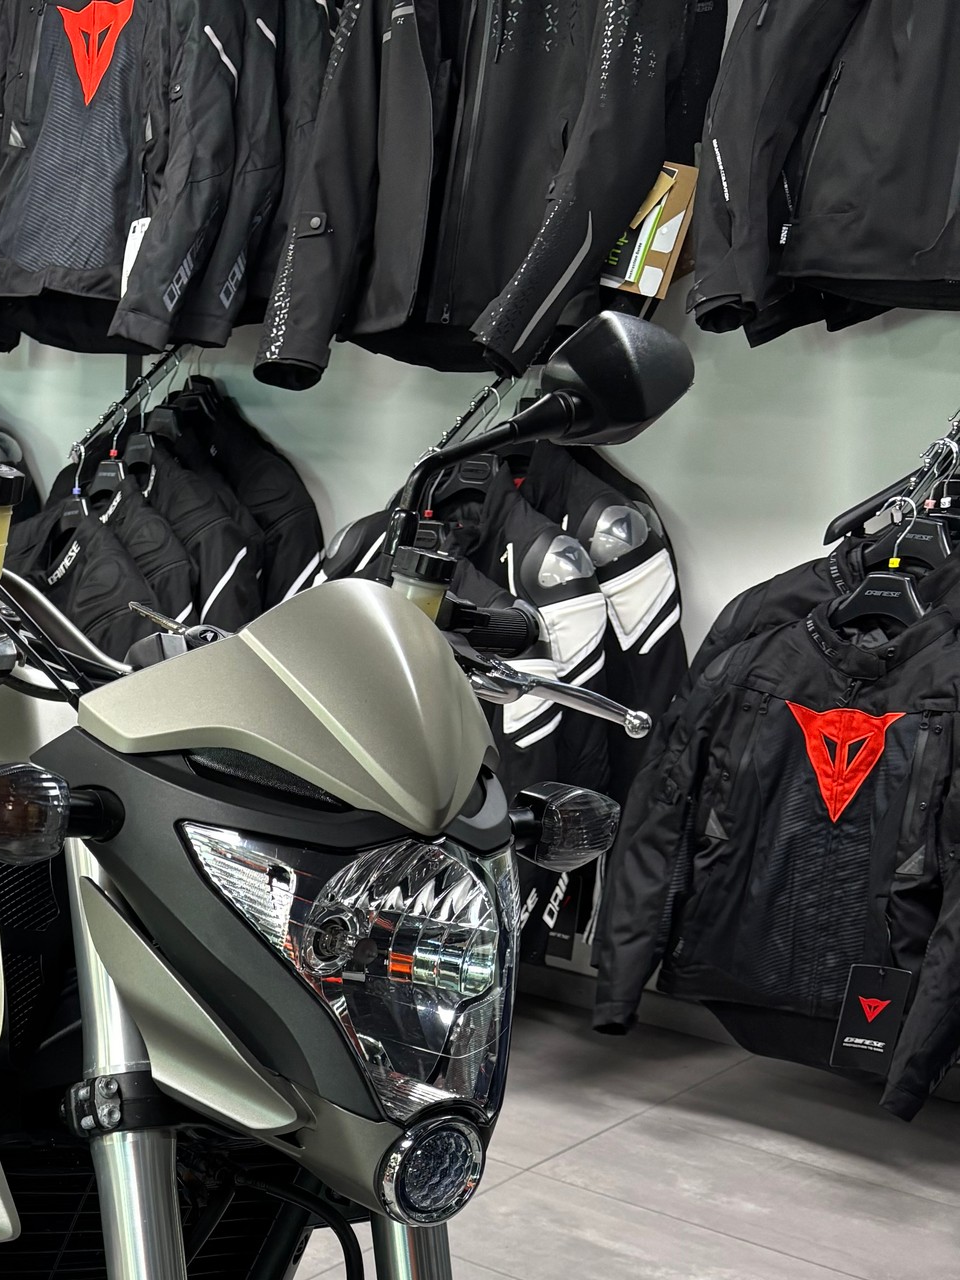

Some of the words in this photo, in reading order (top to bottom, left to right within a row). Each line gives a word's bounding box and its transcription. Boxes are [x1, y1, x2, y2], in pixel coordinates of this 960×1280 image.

[47, 540, 81, 586] DAINESE
[864, 589, 901, 598] DAINESE
[843, 1036, 886, 1048] DAINESE
